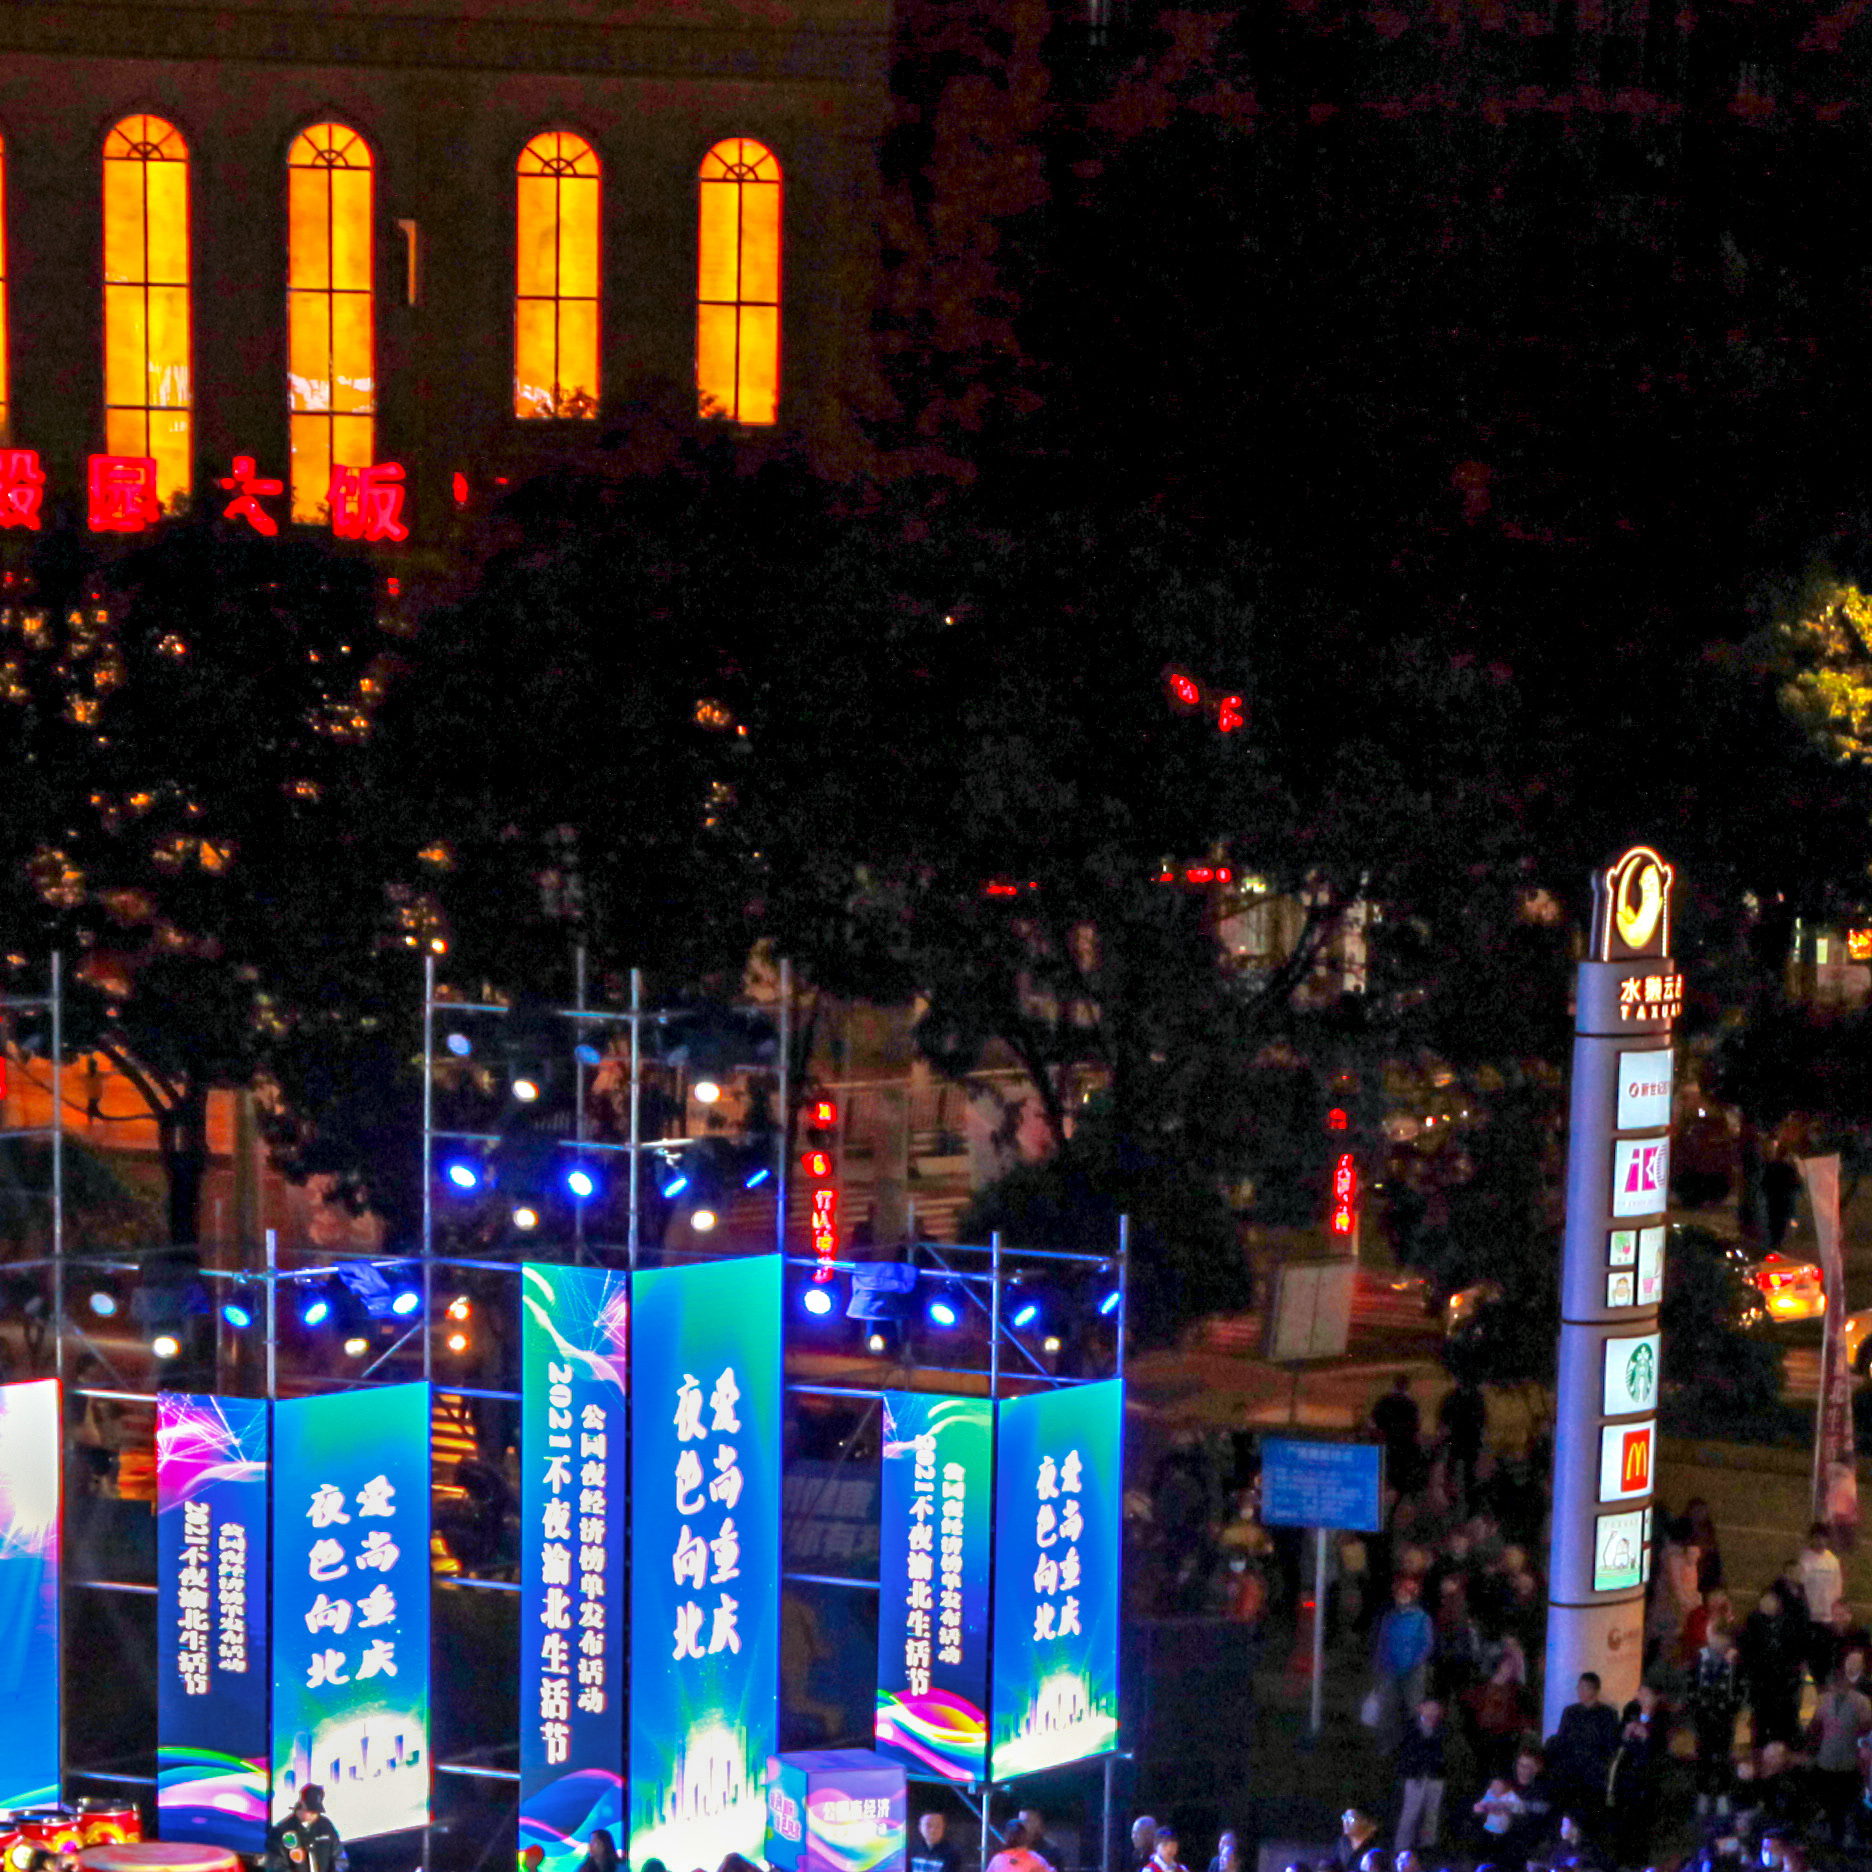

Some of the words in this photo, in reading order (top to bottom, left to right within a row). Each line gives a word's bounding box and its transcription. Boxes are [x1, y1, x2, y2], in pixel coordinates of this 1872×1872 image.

[305, 1484, 354, 1688] 夜色向北
[356, 1475, 400, 1680] 爱尚重庆
[541, 1362, 573, 1765] 2021不夜渝北生活节
[578, 1404, 607, 1713] 公园夜经济榜单发布活动
[673, 1374, 707, 1661] 夜色向北
[708, 1367, 743, 1655] 爱尚重庆
